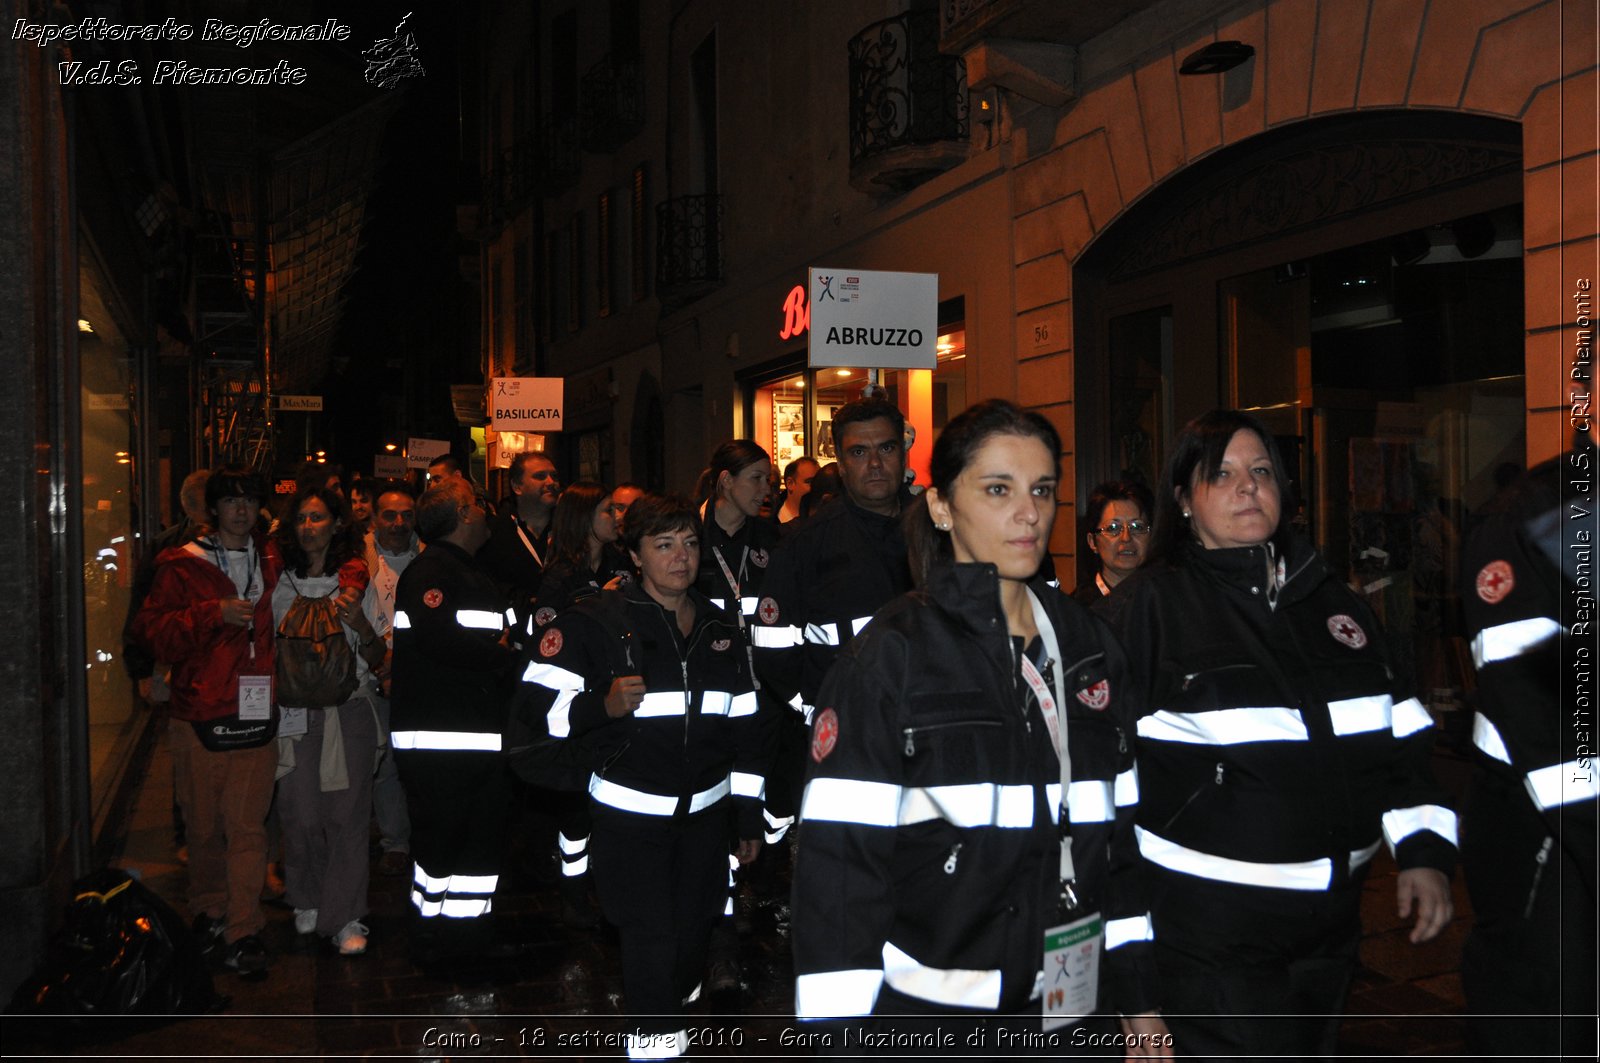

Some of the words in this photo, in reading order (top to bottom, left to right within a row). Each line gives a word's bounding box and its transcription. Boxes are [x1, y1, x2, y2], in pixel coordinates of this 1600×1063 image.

[825, 326, 923, 347] ABRUZZO
[1035, 325, 1048, 342] 56
[496, 408, 560, 420] BASILICATA
[213, 725, 266, 737] Champion
